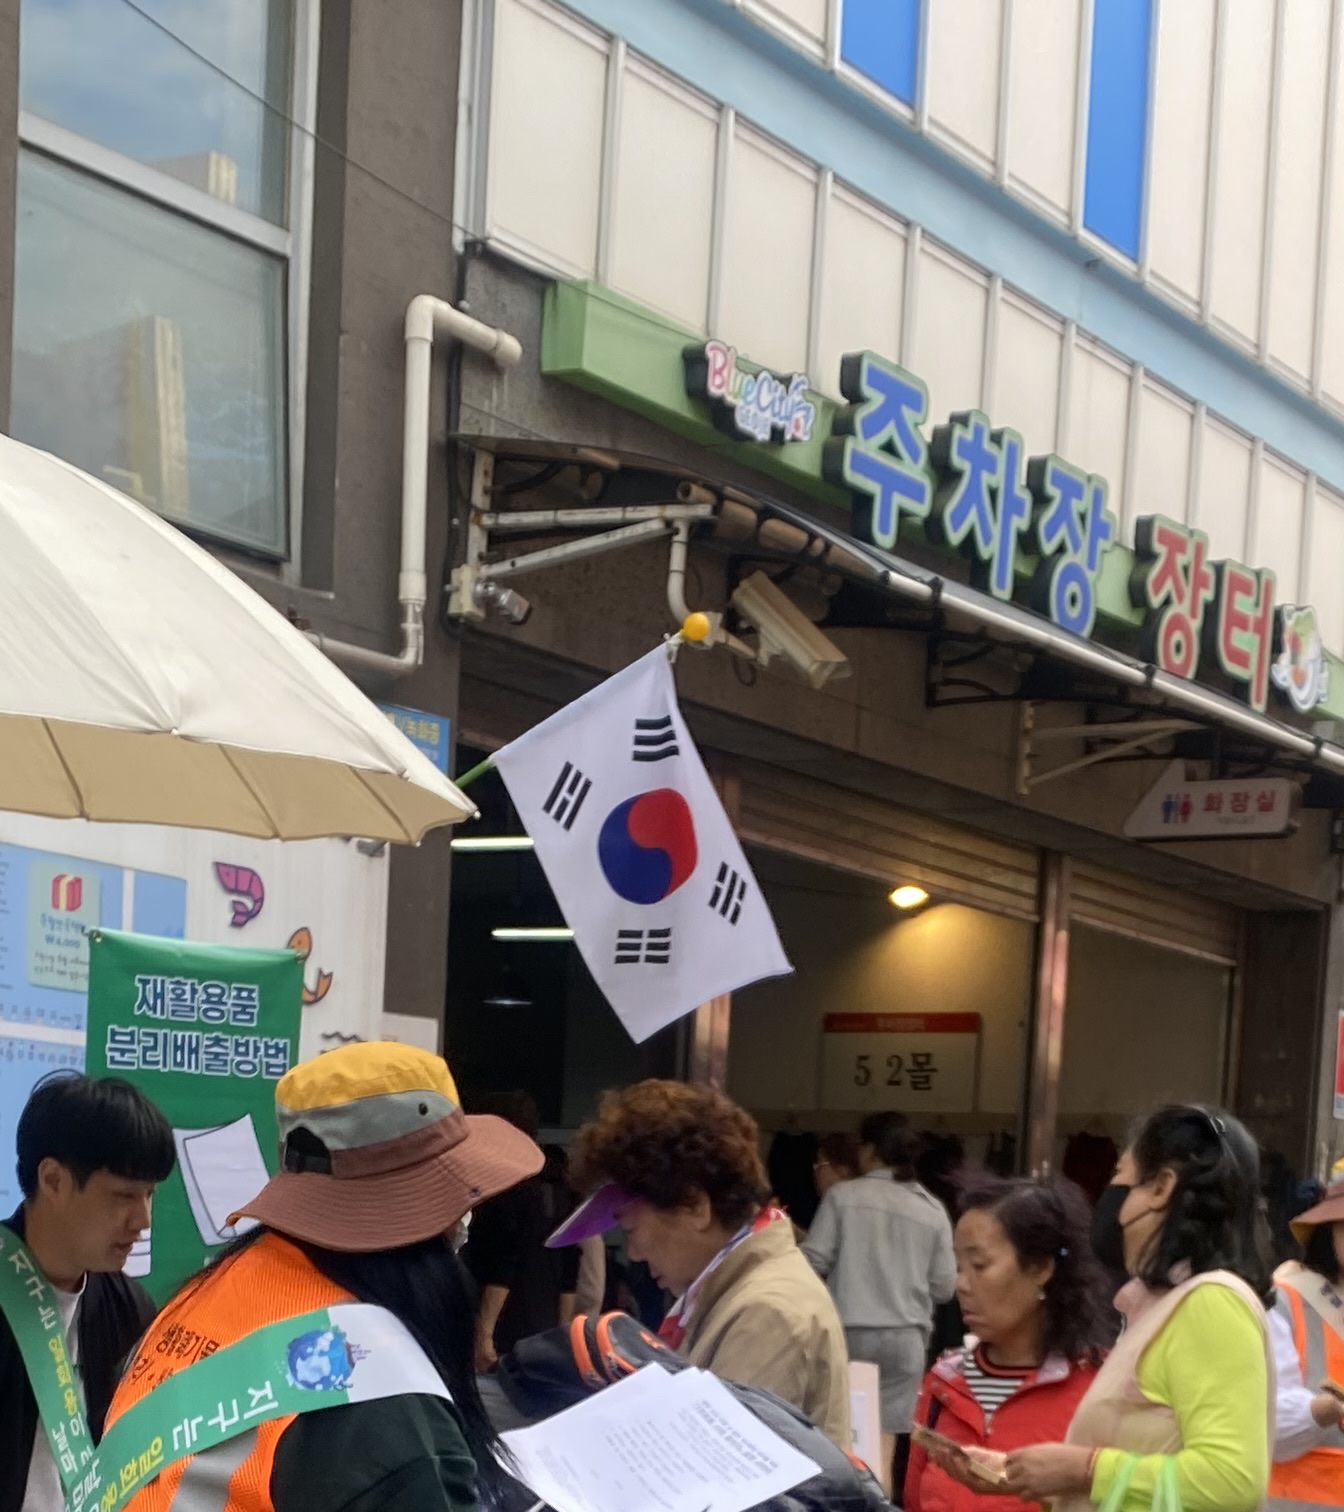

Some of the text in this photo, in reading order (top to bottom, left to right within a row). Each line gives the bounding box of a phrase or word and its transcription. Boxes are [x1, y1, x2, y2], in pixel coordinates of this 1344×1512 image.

[846, 355, 1276, 712] 주차장 장터
[1203, 790, 1276, 814] 화장실
[134, 973, 261, 1027] 재활용품
[106, 1023, 293, 1081] 분리배출방법
[171, 1380, 279, 1452] 지구는
